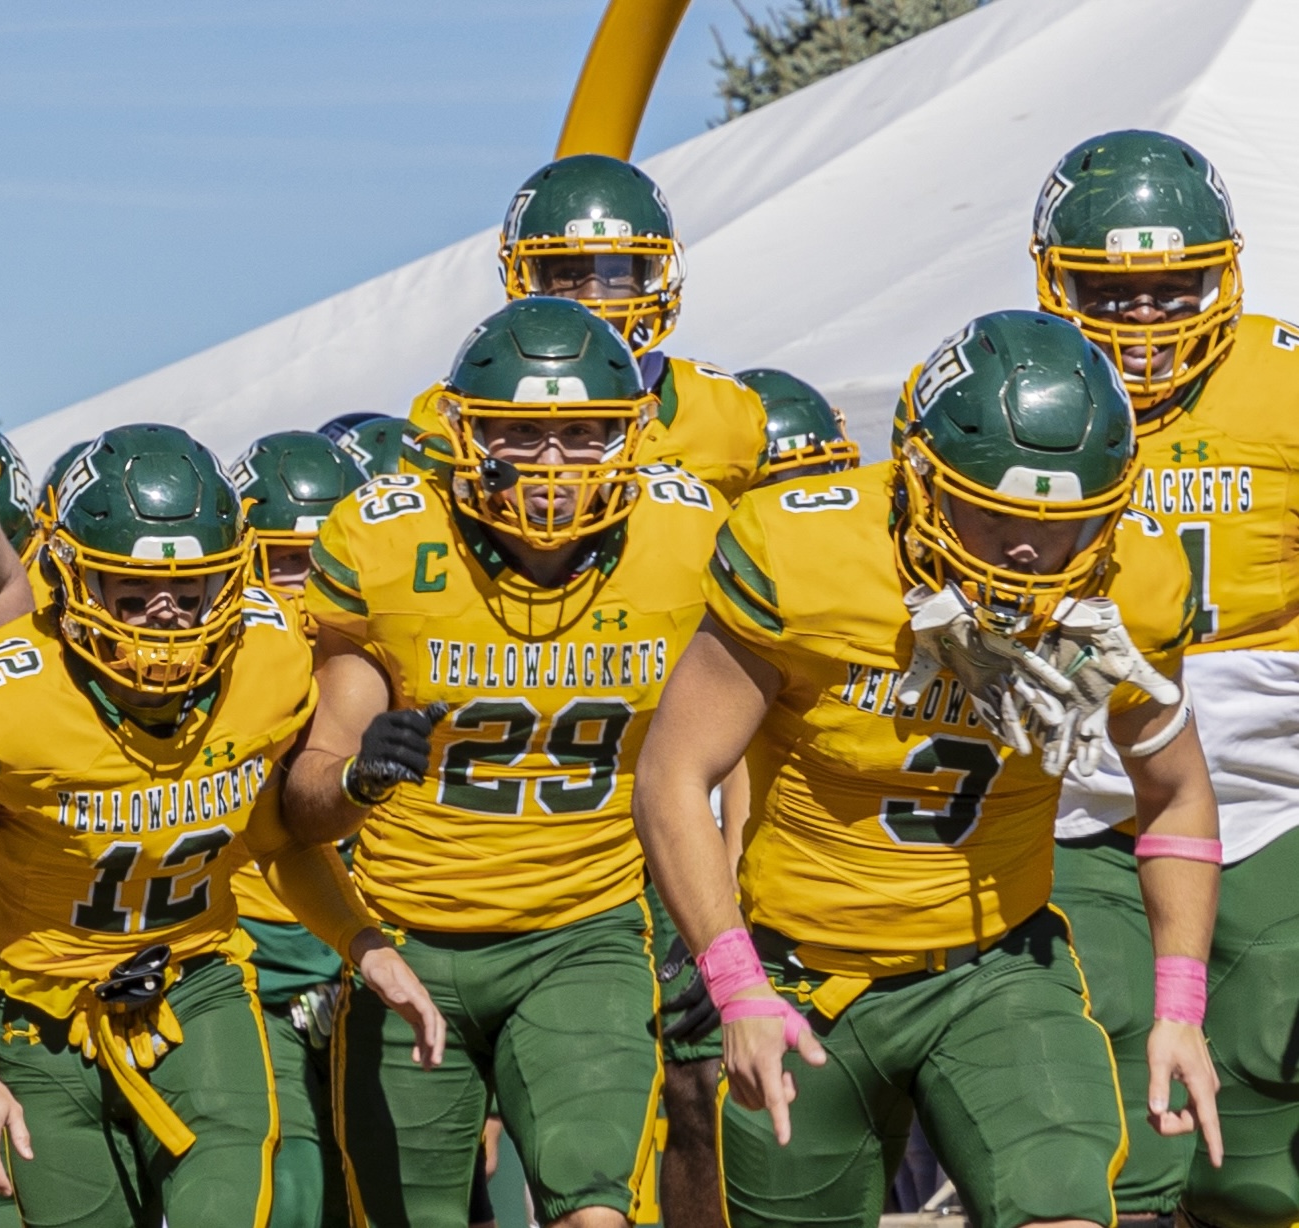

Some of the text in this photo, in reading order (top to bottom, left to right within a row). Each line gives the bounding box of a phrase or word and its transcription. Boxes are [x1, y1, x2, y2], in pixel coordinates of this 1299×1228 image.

[355, 473, 427, 525] 29
[781, 486, 860, 514] 3
[1133, 466, 1253, 515] ACKETS
[412, 542, 449, 594] C
[427, 638, 667, 690] YELLOWJACKETS
[436, 696, 636, 816] 29
[56, 754, 267, 834] YELLOWJACKETS
[878, 732, 1005, 846] 3
[70, 823, 236, 934] 12
